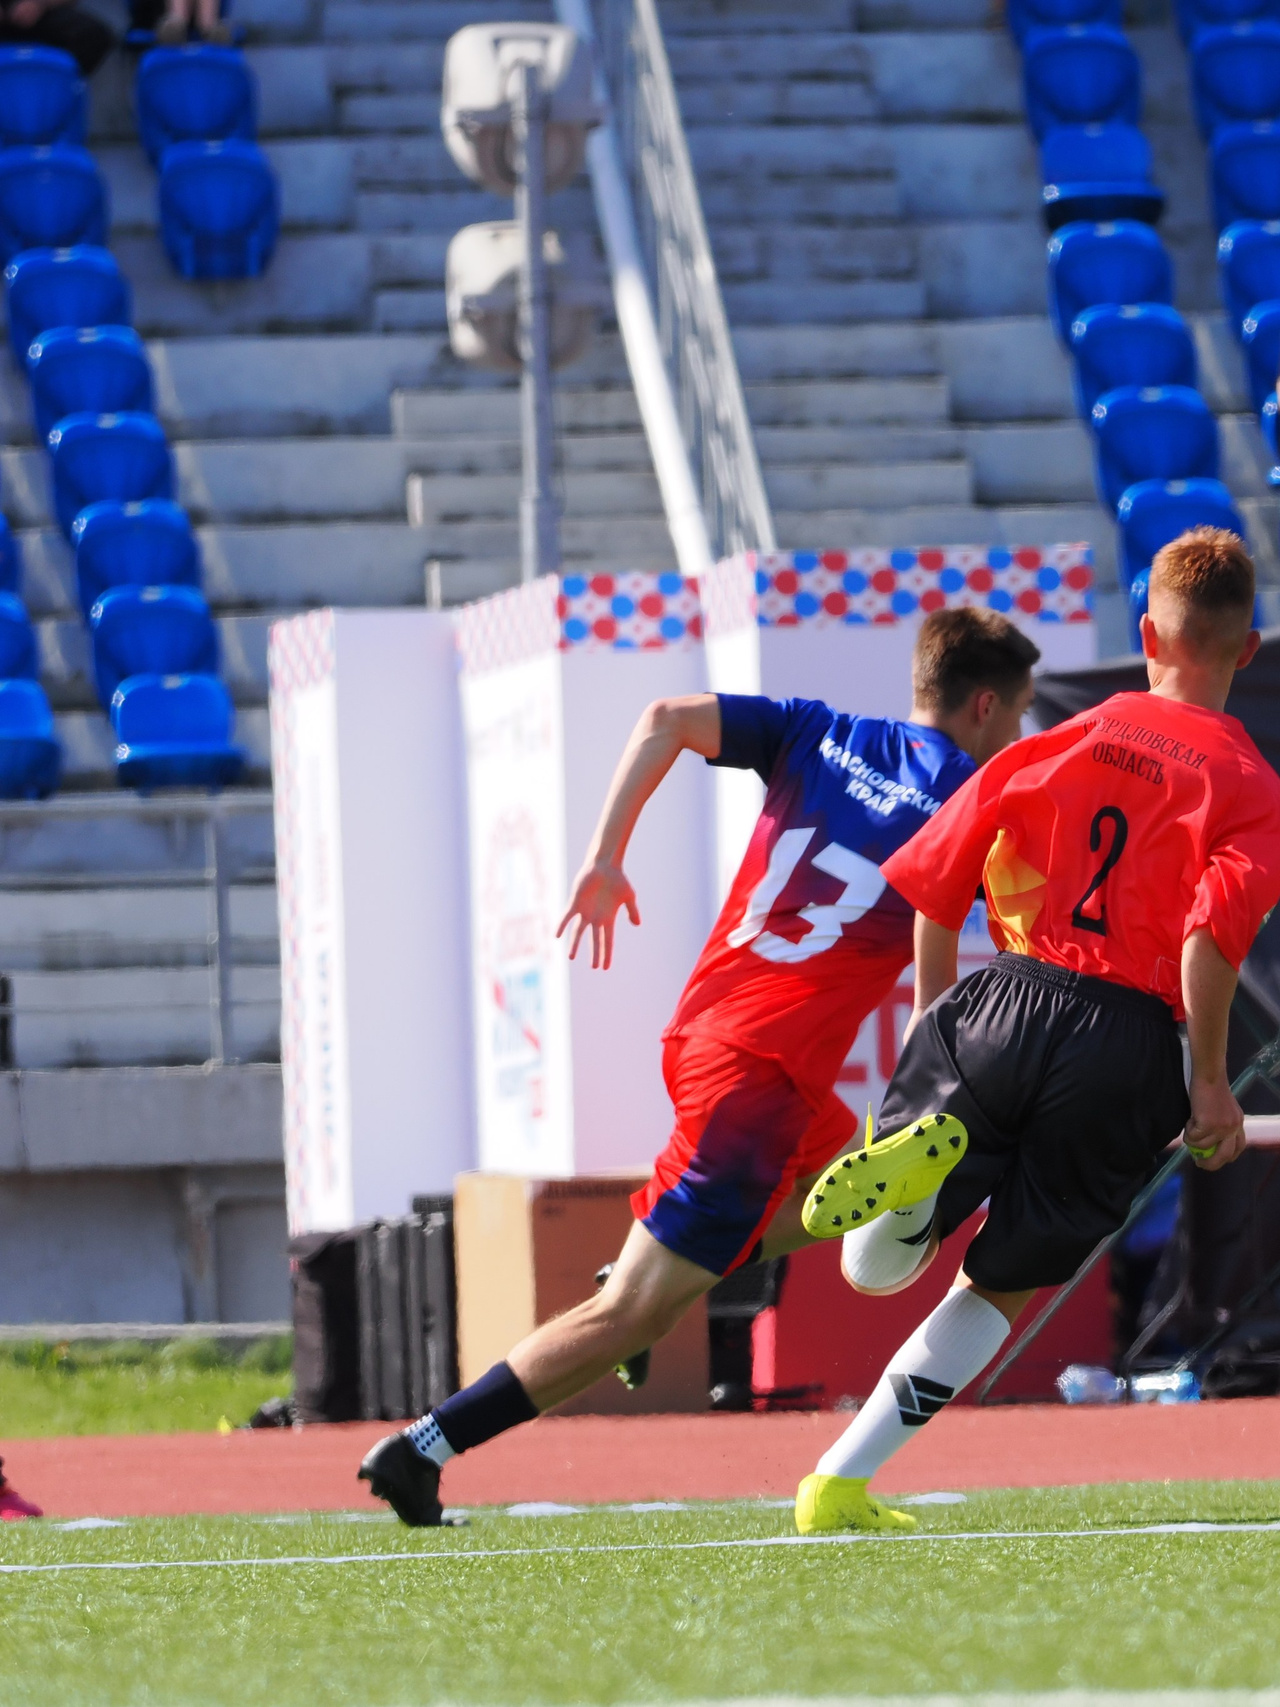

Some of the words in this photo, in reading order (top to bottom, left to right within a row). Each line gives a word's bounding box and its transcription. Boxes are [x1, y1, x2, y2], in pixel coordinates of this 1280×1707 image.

[818, 737, 942, 817] КРАСНОЯРСКИ
[844, 778, 899, 818] КРАЙ
[1091, 740, 1165, 786] ОБЛАСТЬ
[726, 827, 888, 964] 13
[1071, 805, 1128, 938] 2
